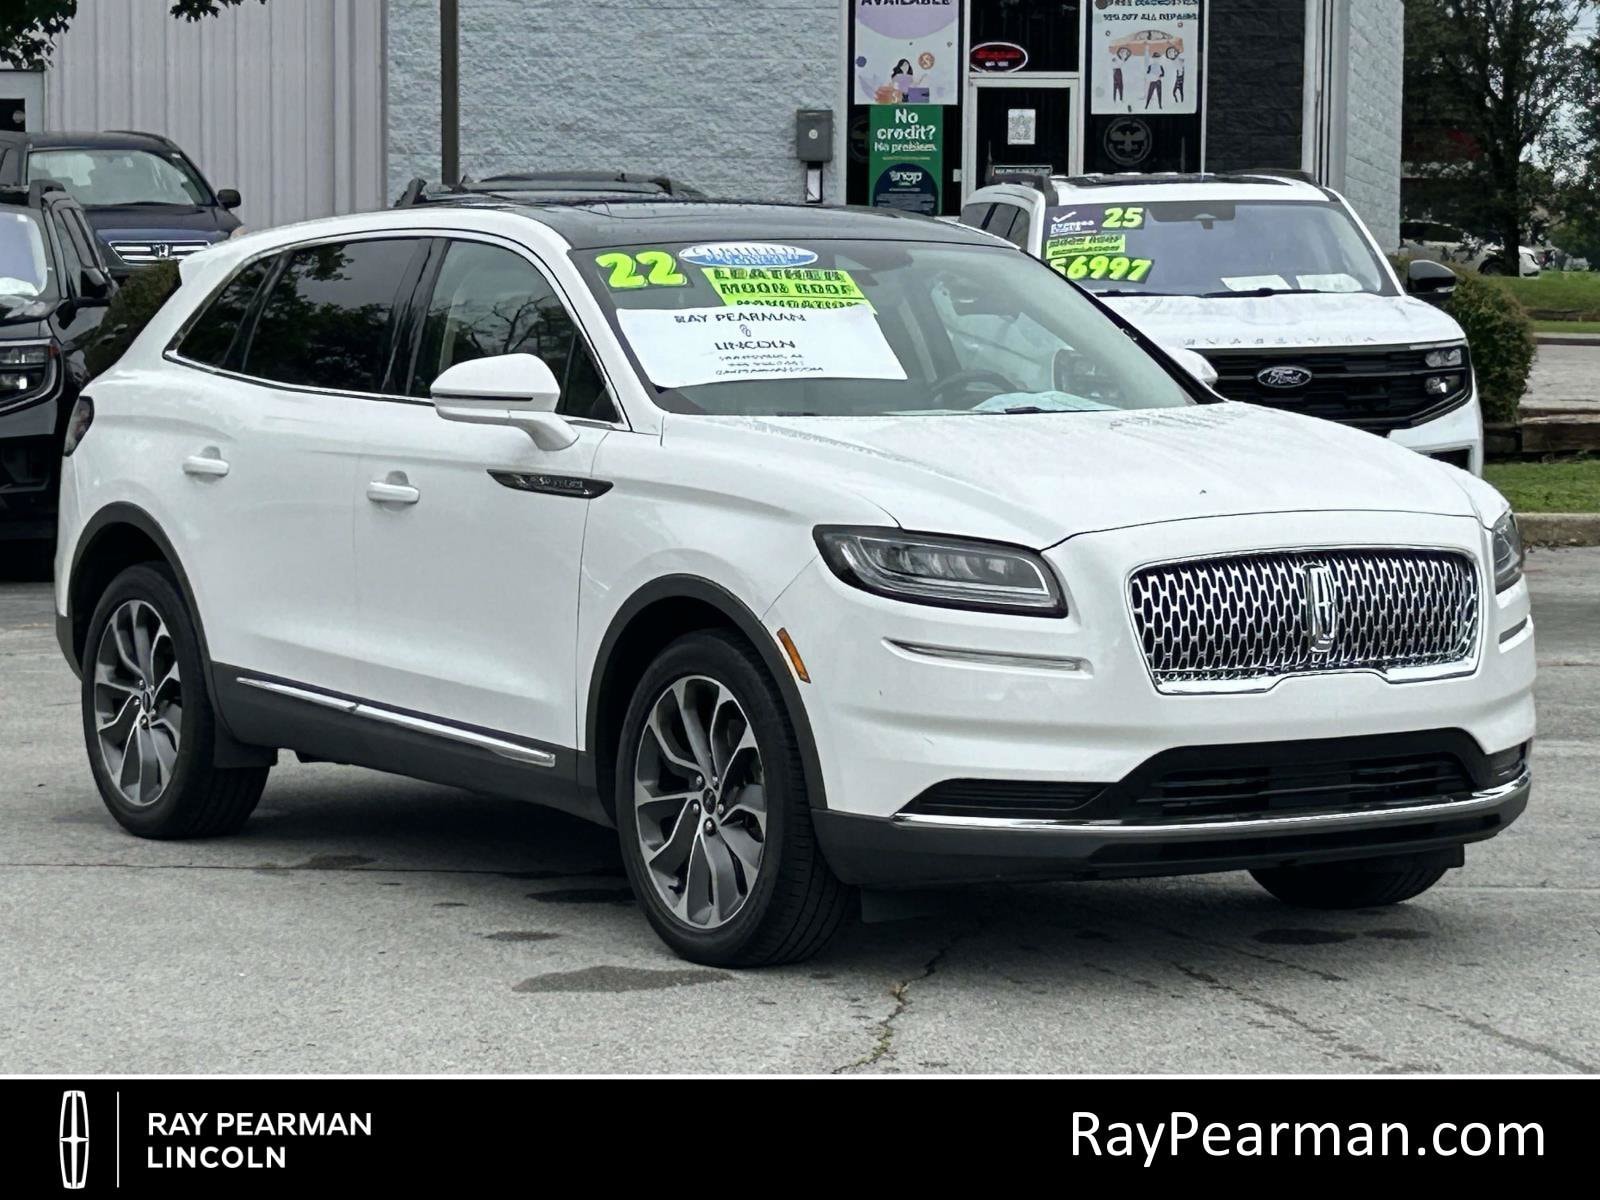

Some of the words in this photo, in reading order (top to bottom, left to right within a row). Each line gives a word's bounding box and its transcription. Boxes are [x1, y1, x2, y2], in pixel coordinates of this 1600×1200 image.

[895, 108, 918, 124] No
[877, 125, 936, 140] credit?
[874, 141, 889, 152] No
[1102, 207, 1144, 229] 25
[595, 251, 686, 289] 22
[713, 268, 847, 281] LEATHER
[720, 283, 788, 295] MOON
[674, 315, 708, 324] RAY
[715, 312, 807, 323] PEARMAN
[714, 340, 796, 351] LINCOLN
[1268, 369, 1301, 385] Ford
